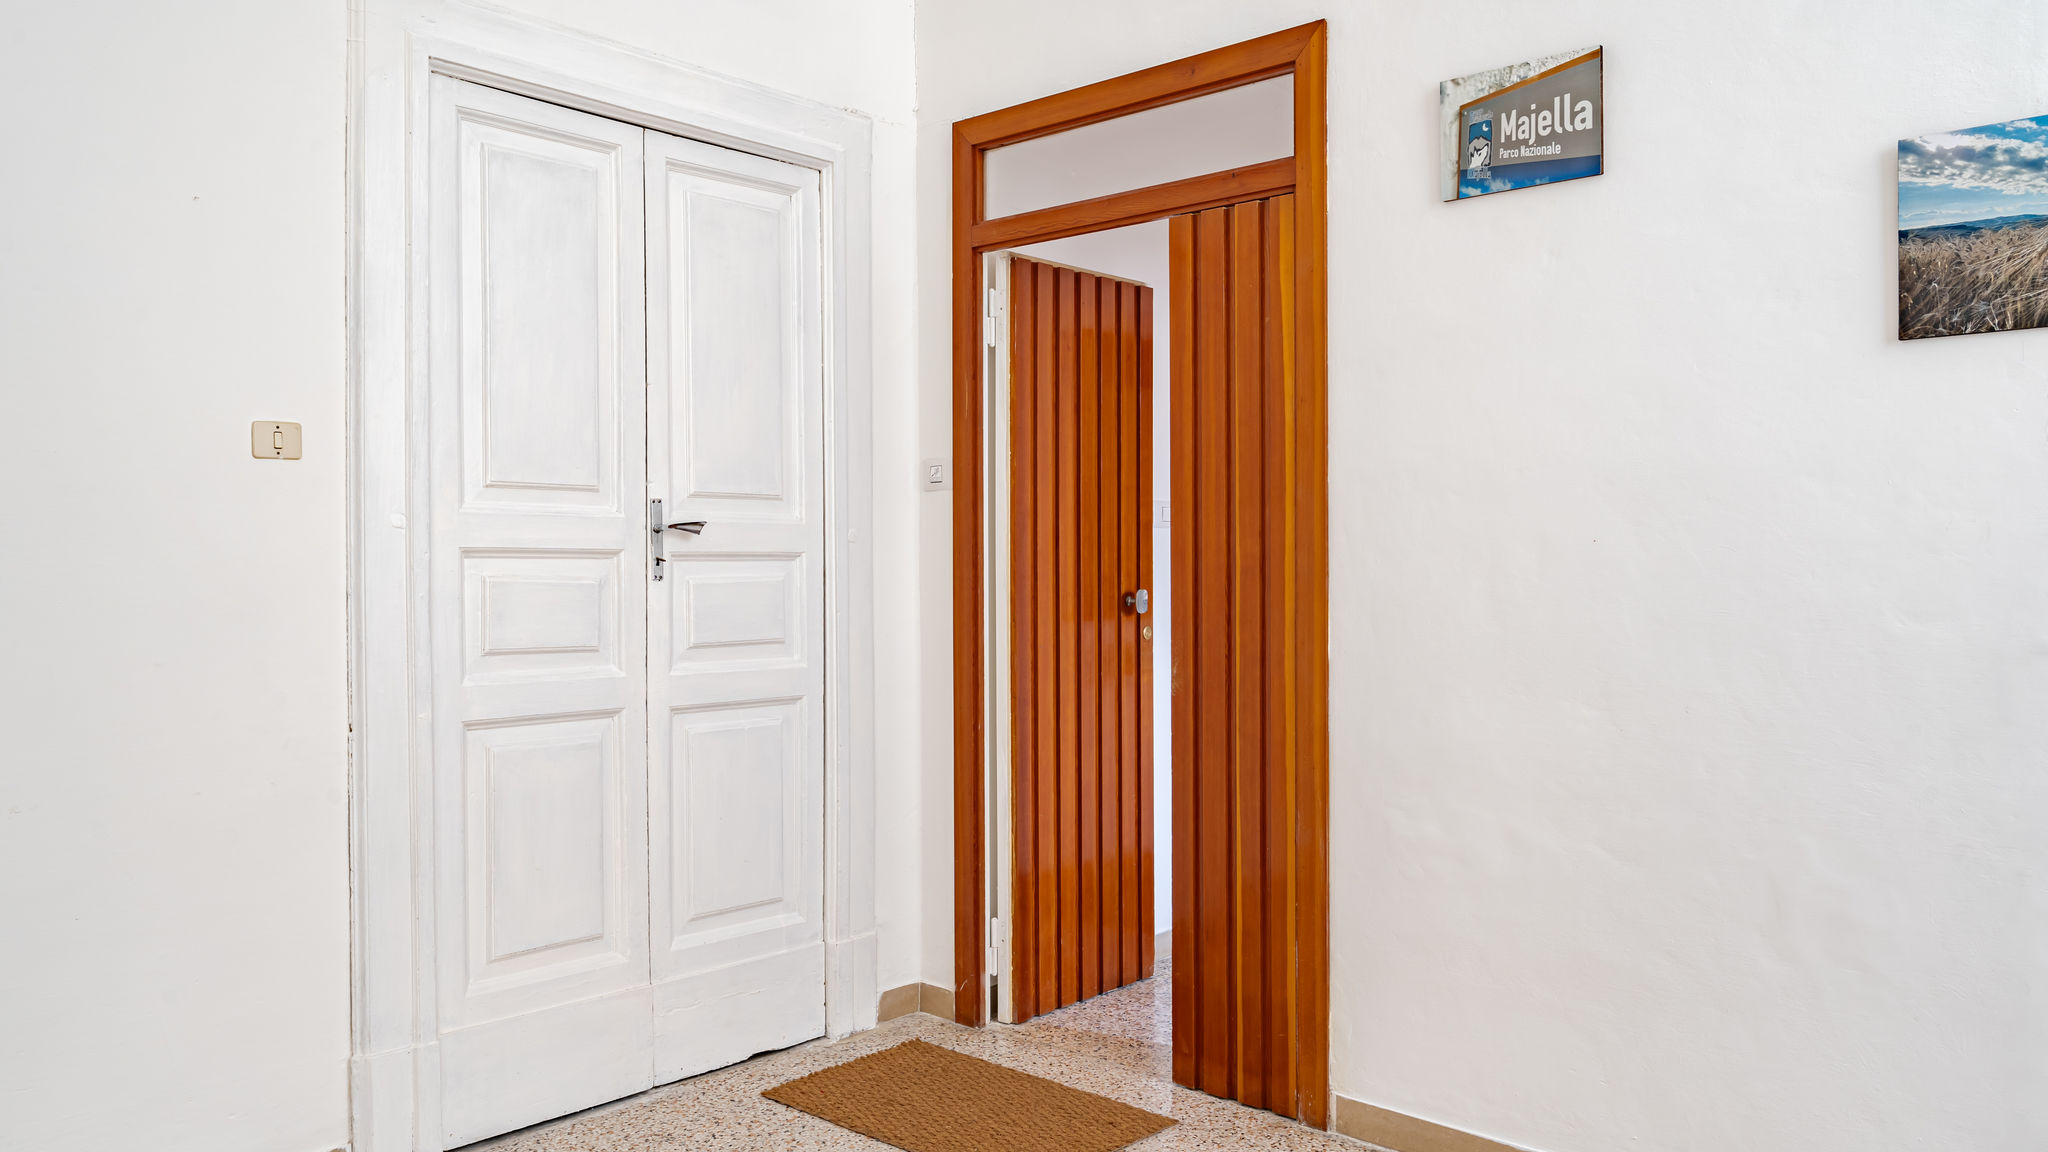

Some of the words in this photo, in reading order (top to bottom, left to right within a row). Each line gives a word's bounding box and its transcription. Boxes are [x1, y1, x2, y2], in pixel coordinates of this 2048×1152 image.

[1501, 93, 1593, 145] Majella
[1499, 147, 1519, 159] Parco
[1520, 141, 1561, 157] Nazionale
